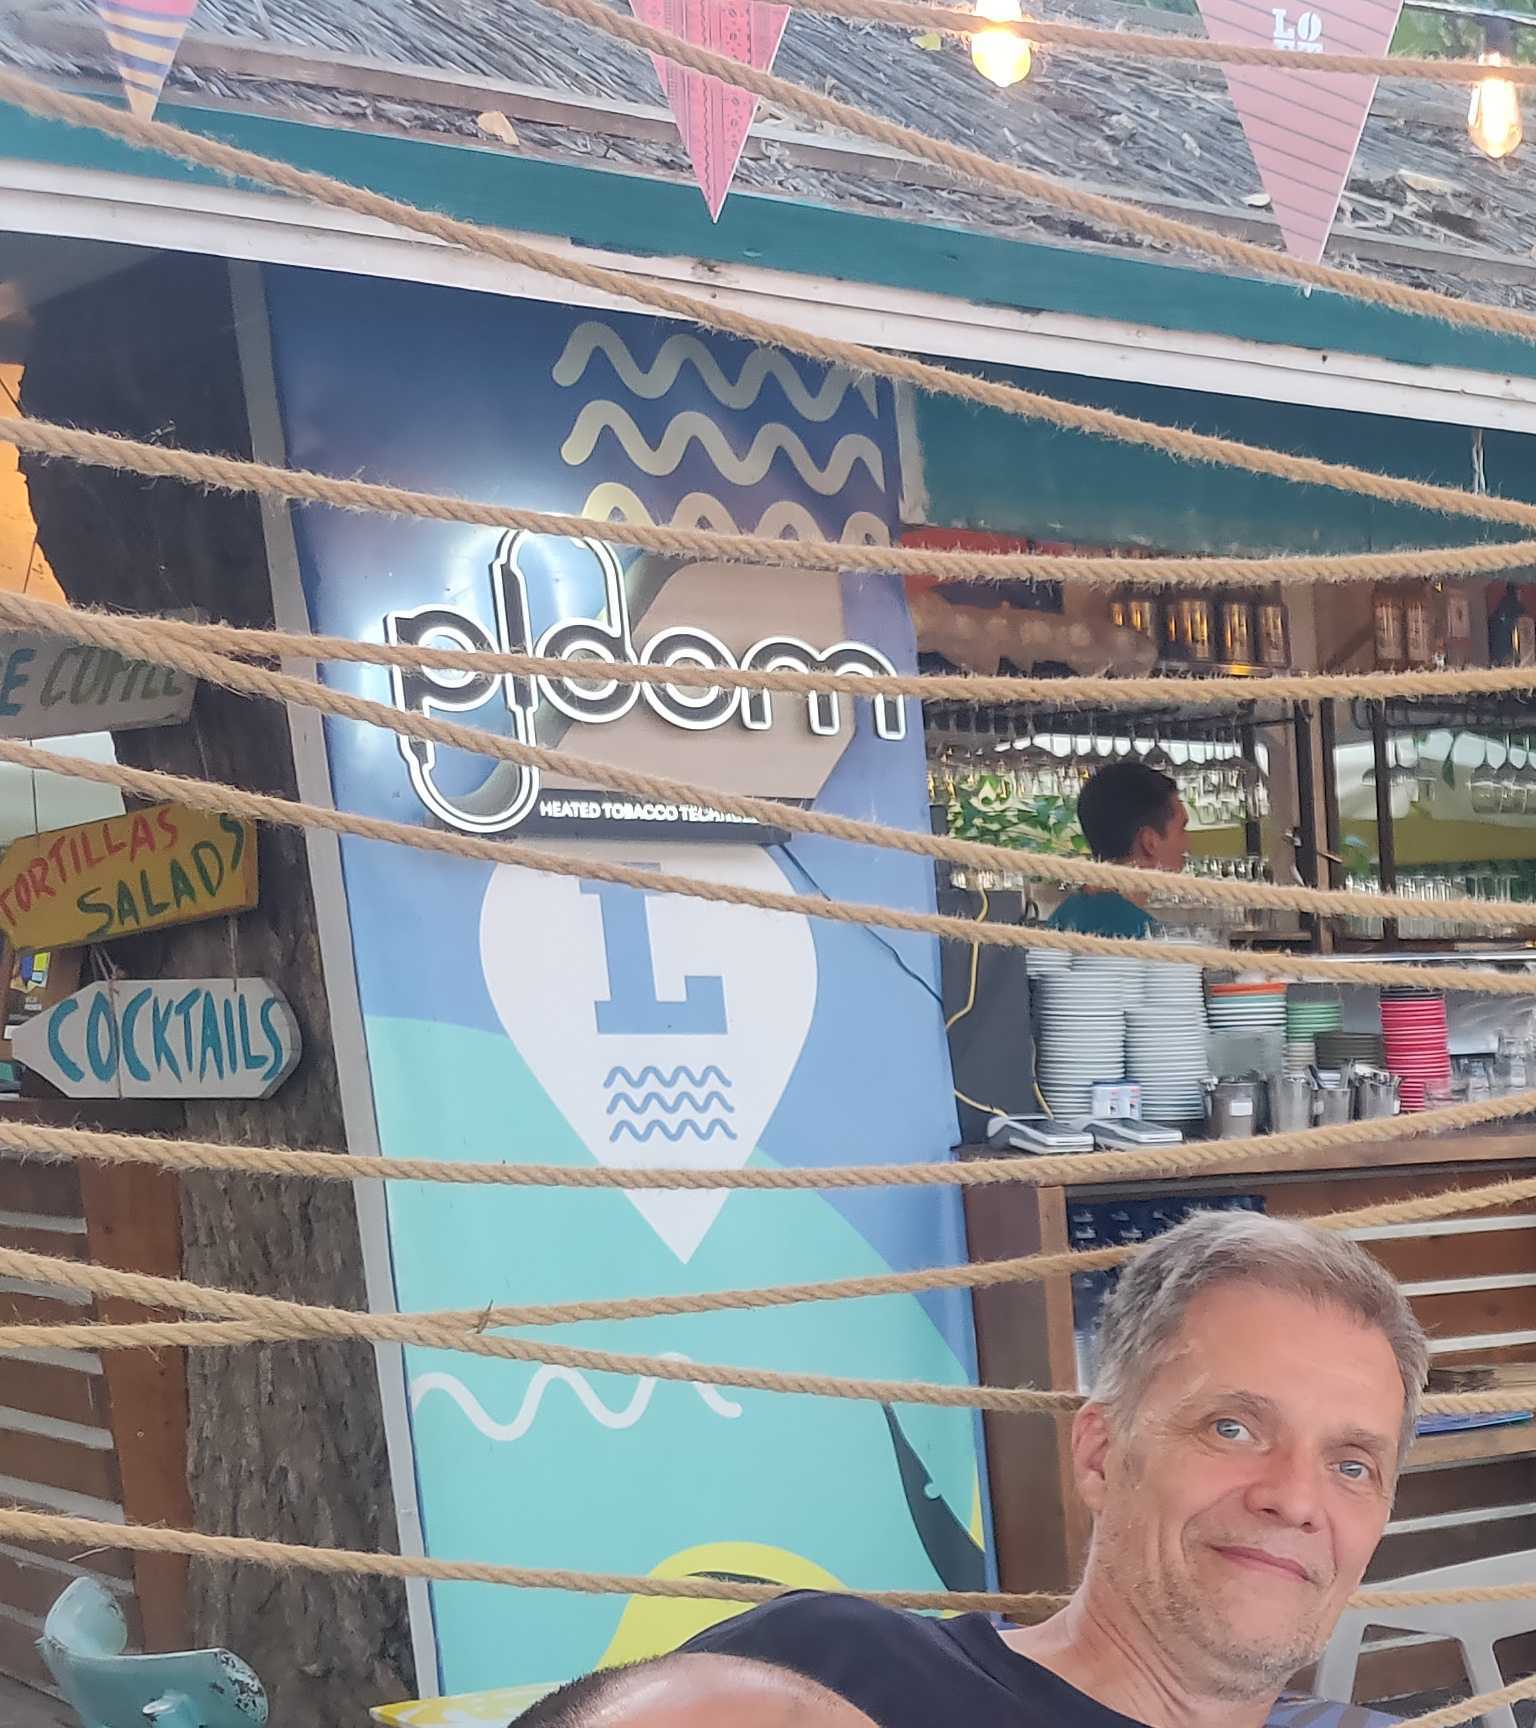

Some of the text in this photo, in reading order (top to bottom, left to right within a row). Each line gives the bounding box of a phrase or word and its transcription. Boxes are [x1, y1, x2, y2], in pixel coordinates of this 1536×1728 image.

[539, 800, 601, 819] HEATED
[602, 801, 678, 822] TOBACCO
[0, 808, 179, 926] TORTILLAS
[77, 813, 245, 938] SALADS
[48, 988, 284, 1083] COCKTAILS
